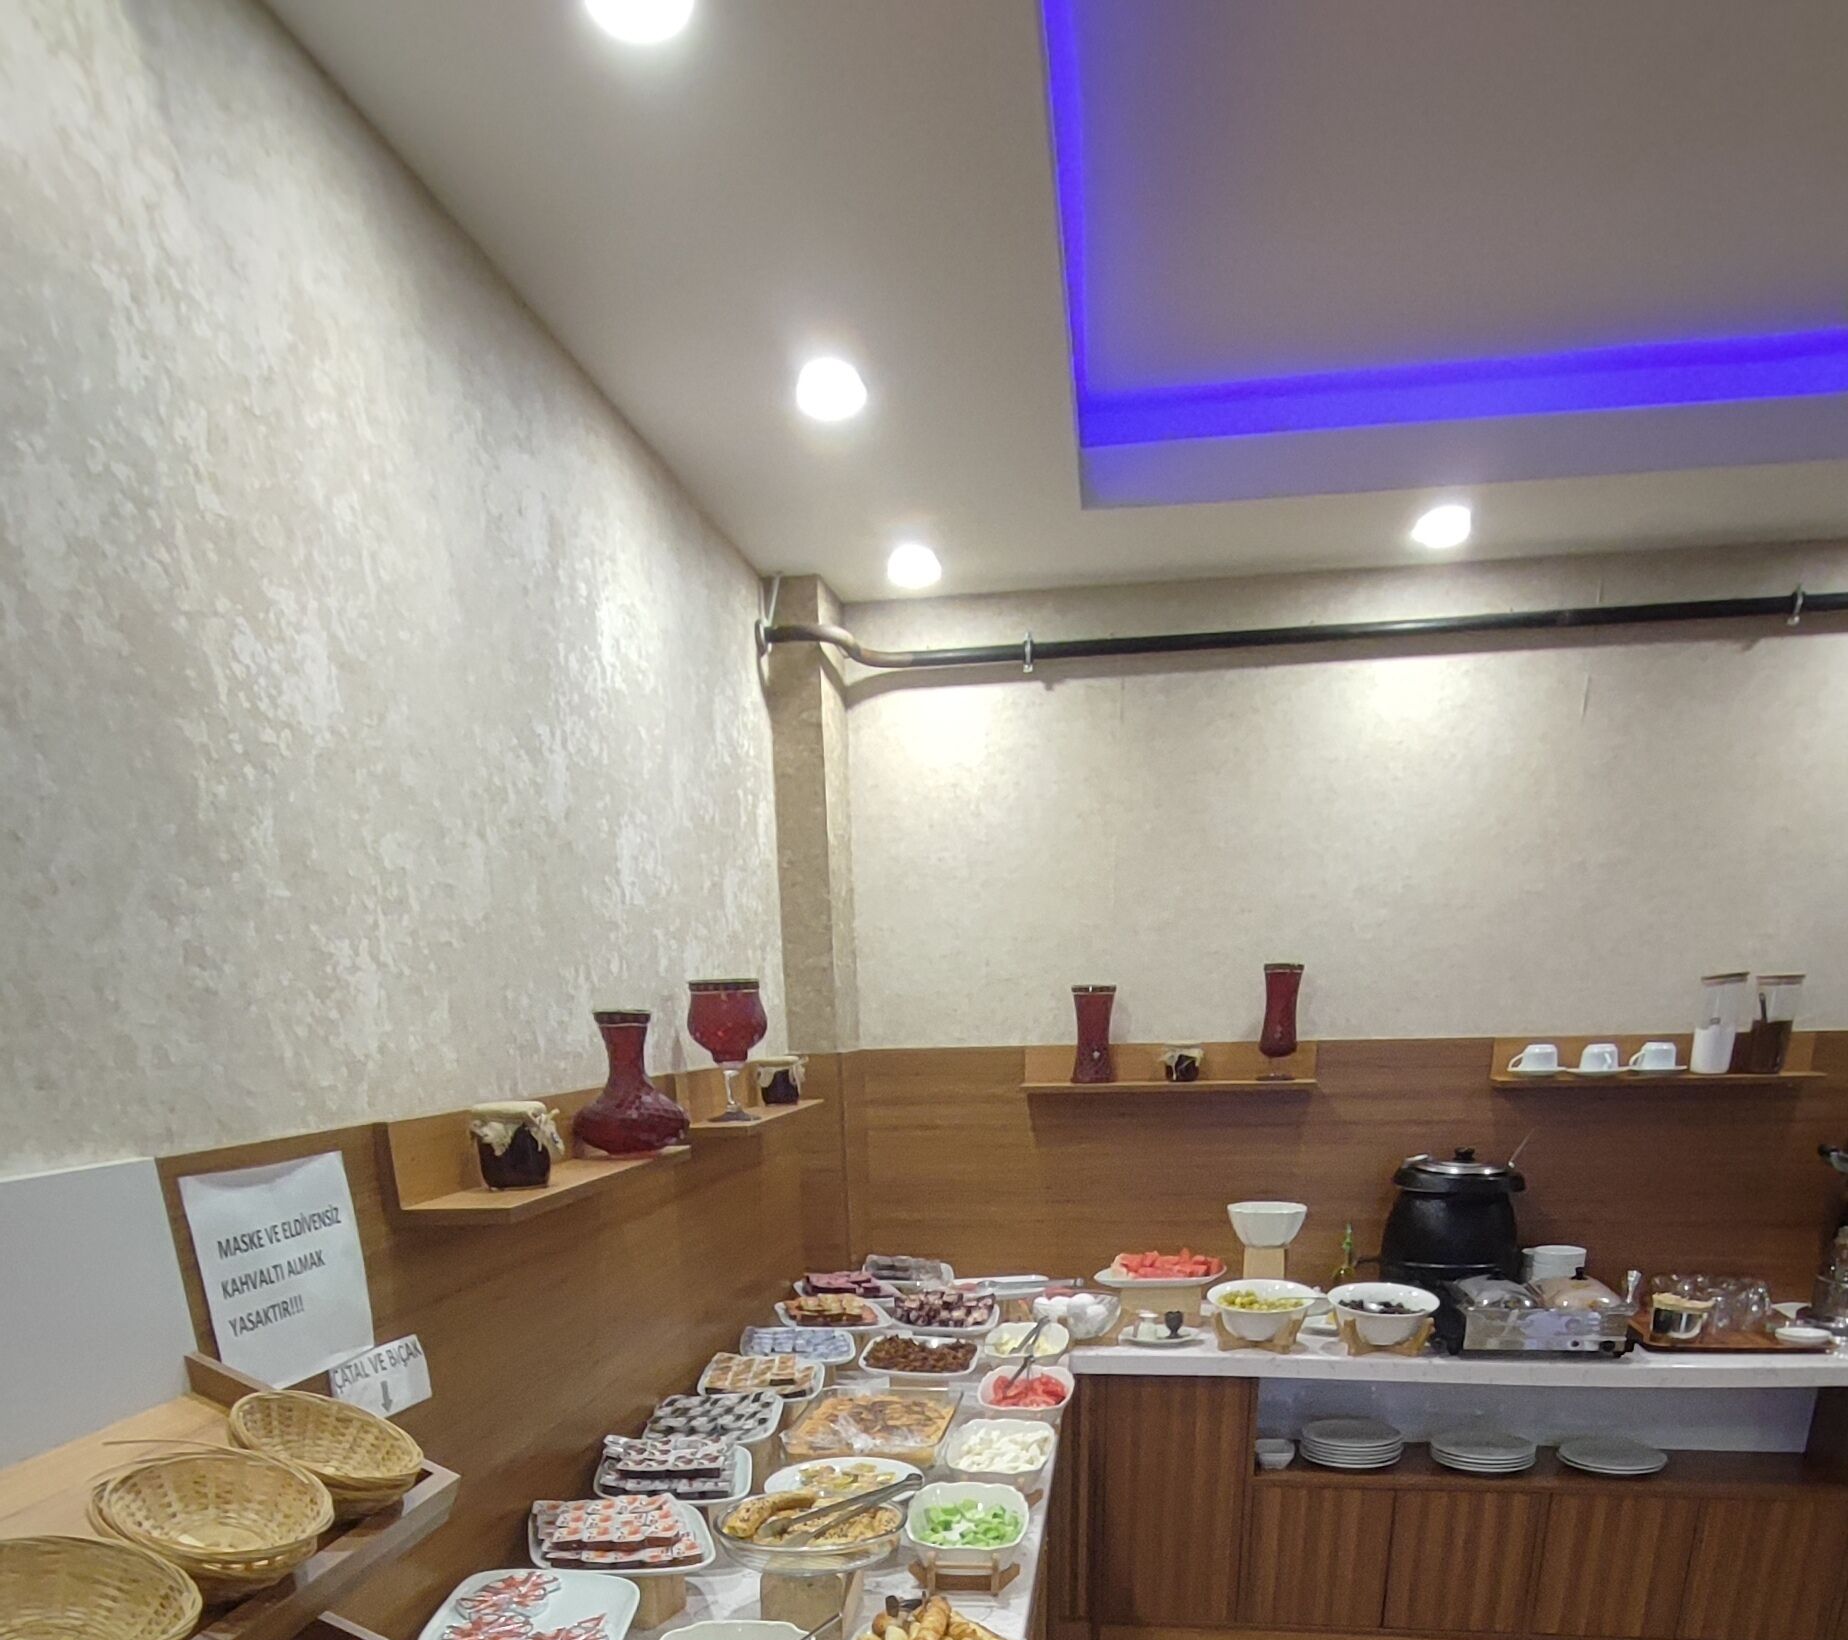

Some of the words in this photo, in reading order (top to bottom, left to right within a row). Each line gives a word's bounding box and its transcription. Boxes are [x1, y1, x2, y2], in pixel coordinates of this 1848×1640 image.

[217, 1229, 265, 1260] MASKE
[264, 1224, 282, 1244] VE
[281, 1204, 342, 1240] ELDİVENSİZ
[221, 1263, 285, 1300] KAHVALTI
[287, 1249, 326, 1277] ALMAK
[228, 1294, 305, 1337] YASAKTIR!!!
[333, 1360, 371, 1394] ÇATAL
[367, 1352, 388, 1374] VE
